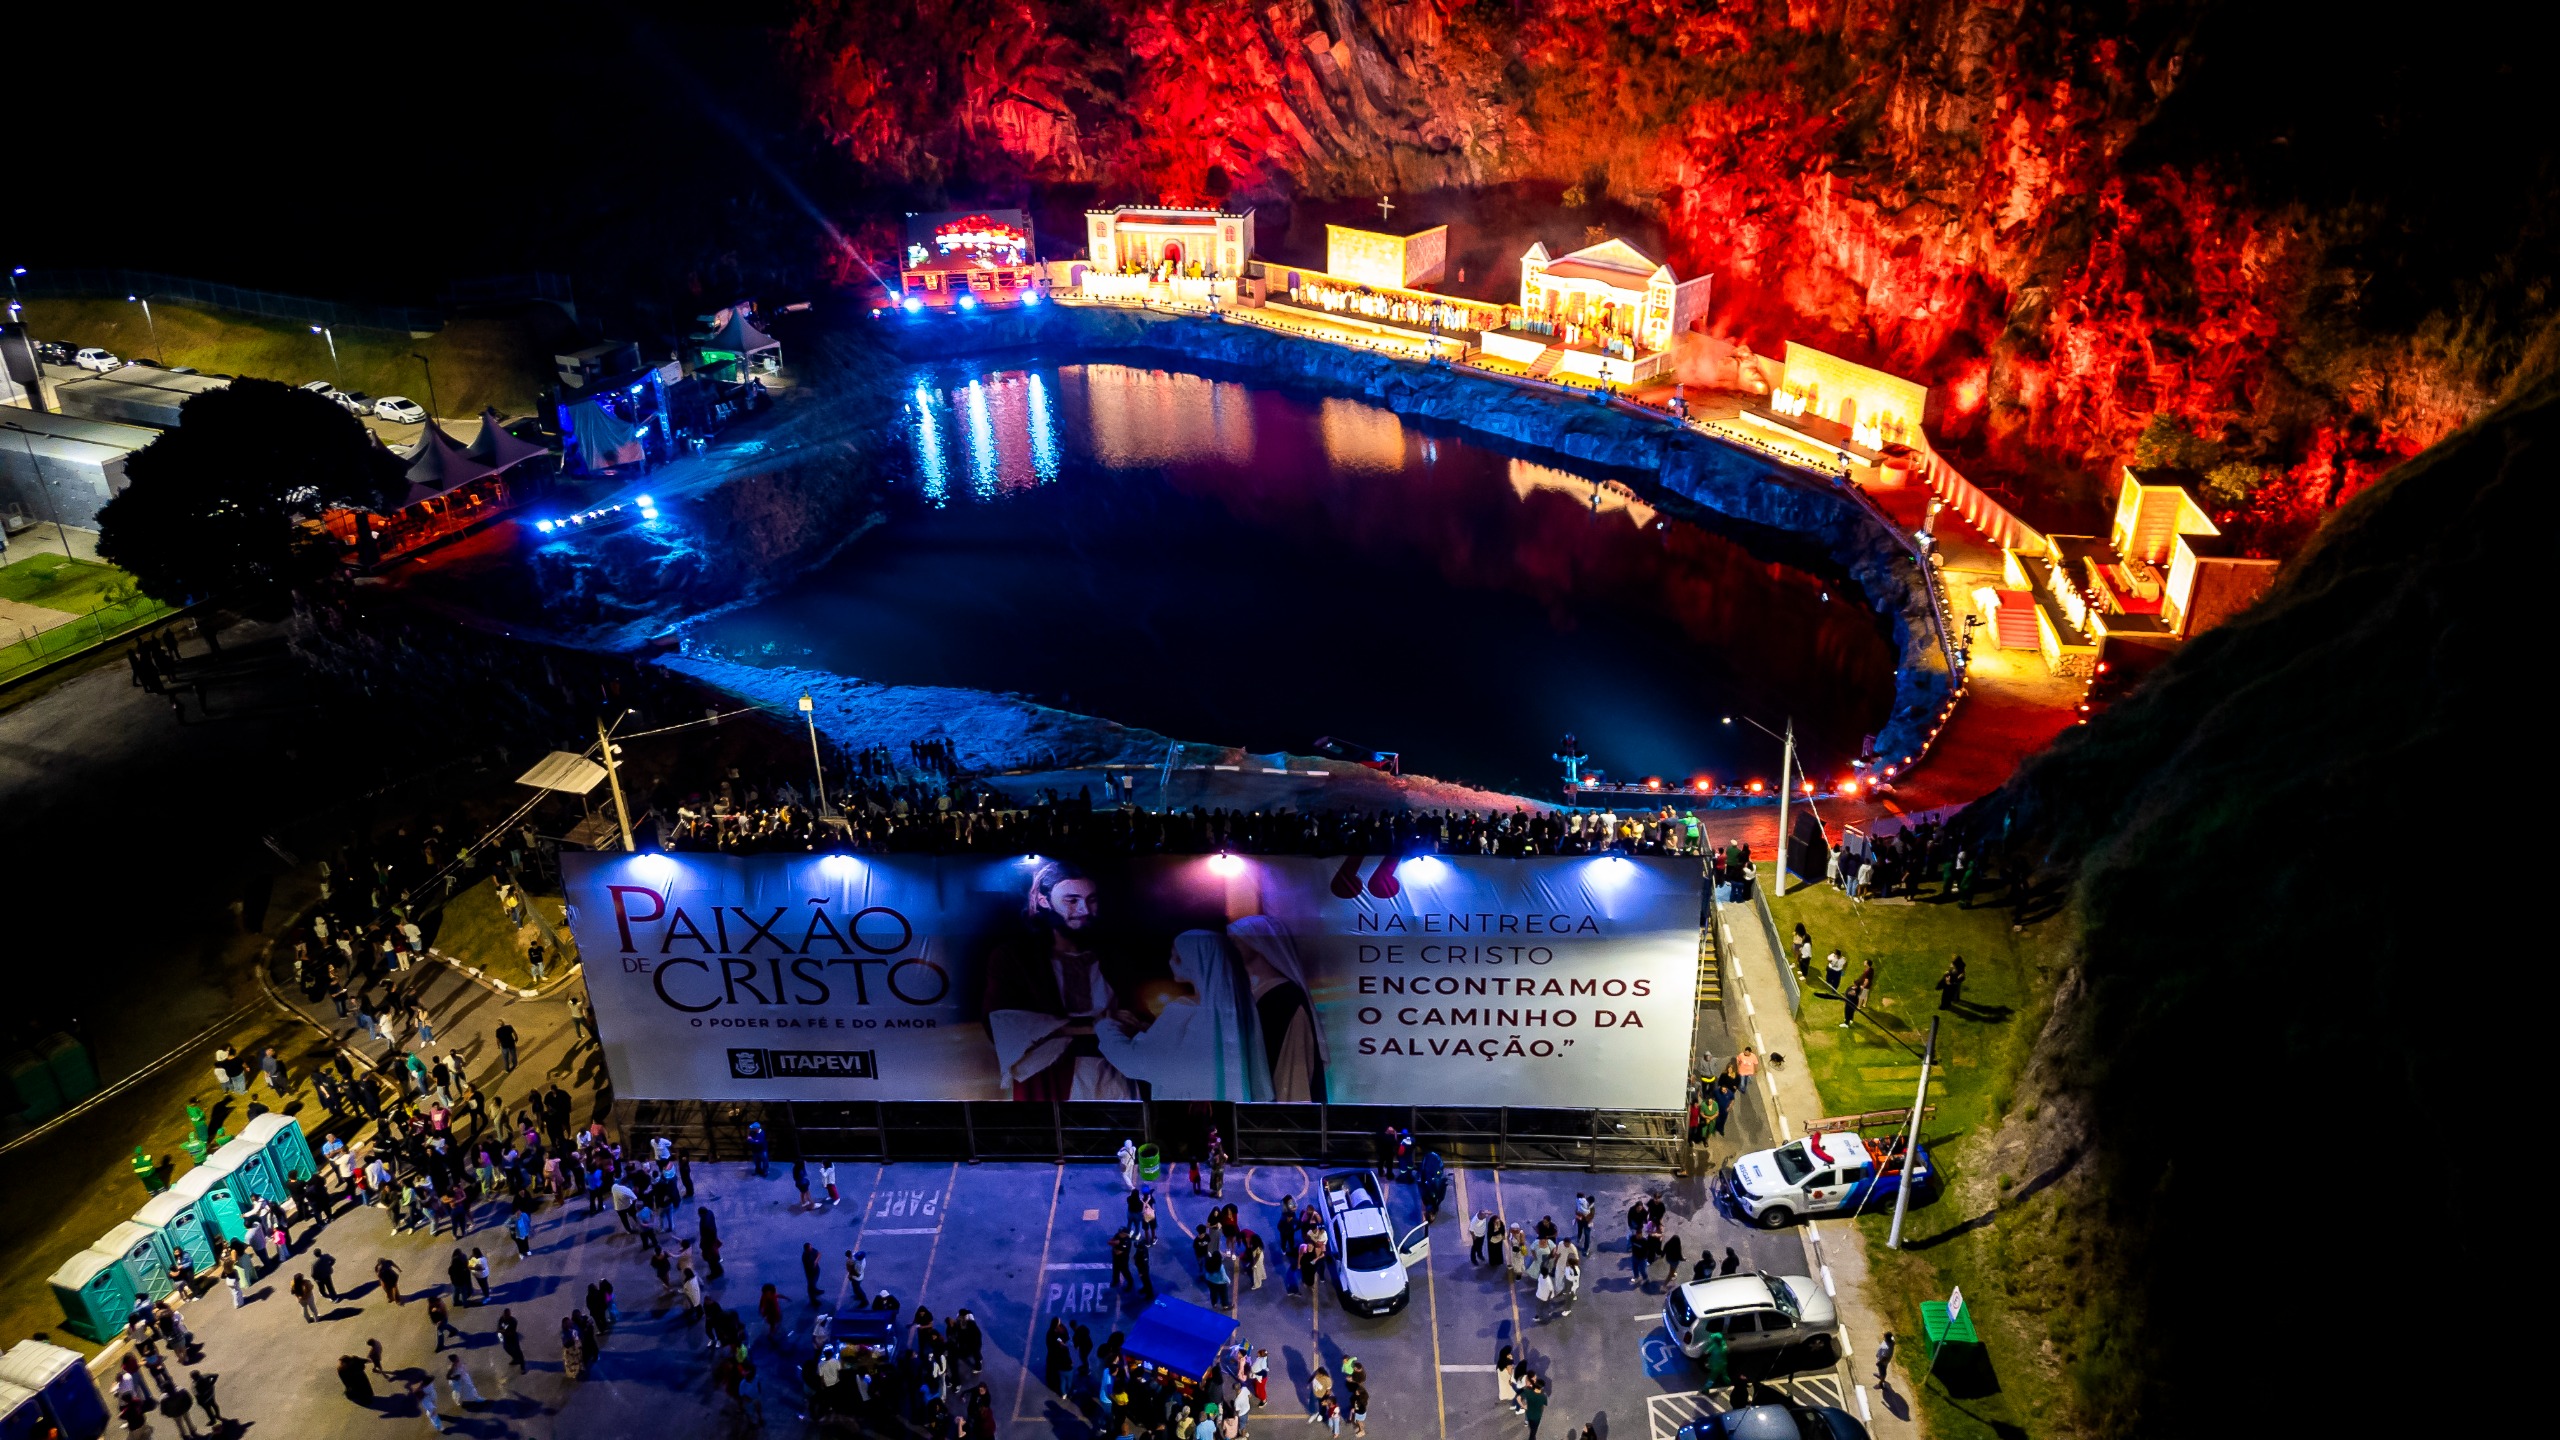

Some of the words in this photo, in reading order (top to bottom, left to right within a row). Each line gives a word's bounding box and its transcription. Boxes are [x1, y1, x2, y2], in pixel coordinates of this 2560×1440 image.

[606, 885, 912, 955] PAIXÃO
[1358, 913, 1407, 933] NA
[1424, 913, 1601, 935] ENTREGA
[1360, 945, 1404, 964] DE
[1421, 946, 1553, 966] CRISTO
[623, 957, 652, 974] DE
[652, 957, 950, 1013] CRISTO
[1358, 976, 1651, 998] ENCONTRAMOS
[690, 1018, 703, 1028] O
[709, 1018, 770, 1029] PODER
[777, 1018, 802, 1028] DA
[808, 1016, 829, 1028] FÉ
[836, 1018, 845, 1028] E
[852, 1018, 878, 1029] DO
[884, 1018, 937, 1029] AMOR
[1358, 1007, 1382, 1026] O
[1397, 1007, 1578, 1029] CAMINHO
[1594, 1010, 1644, 1029] DA
[779, 1055, 862, 1070] ITAPEVI
[1045, 1282, 1111, 1314] PARE
